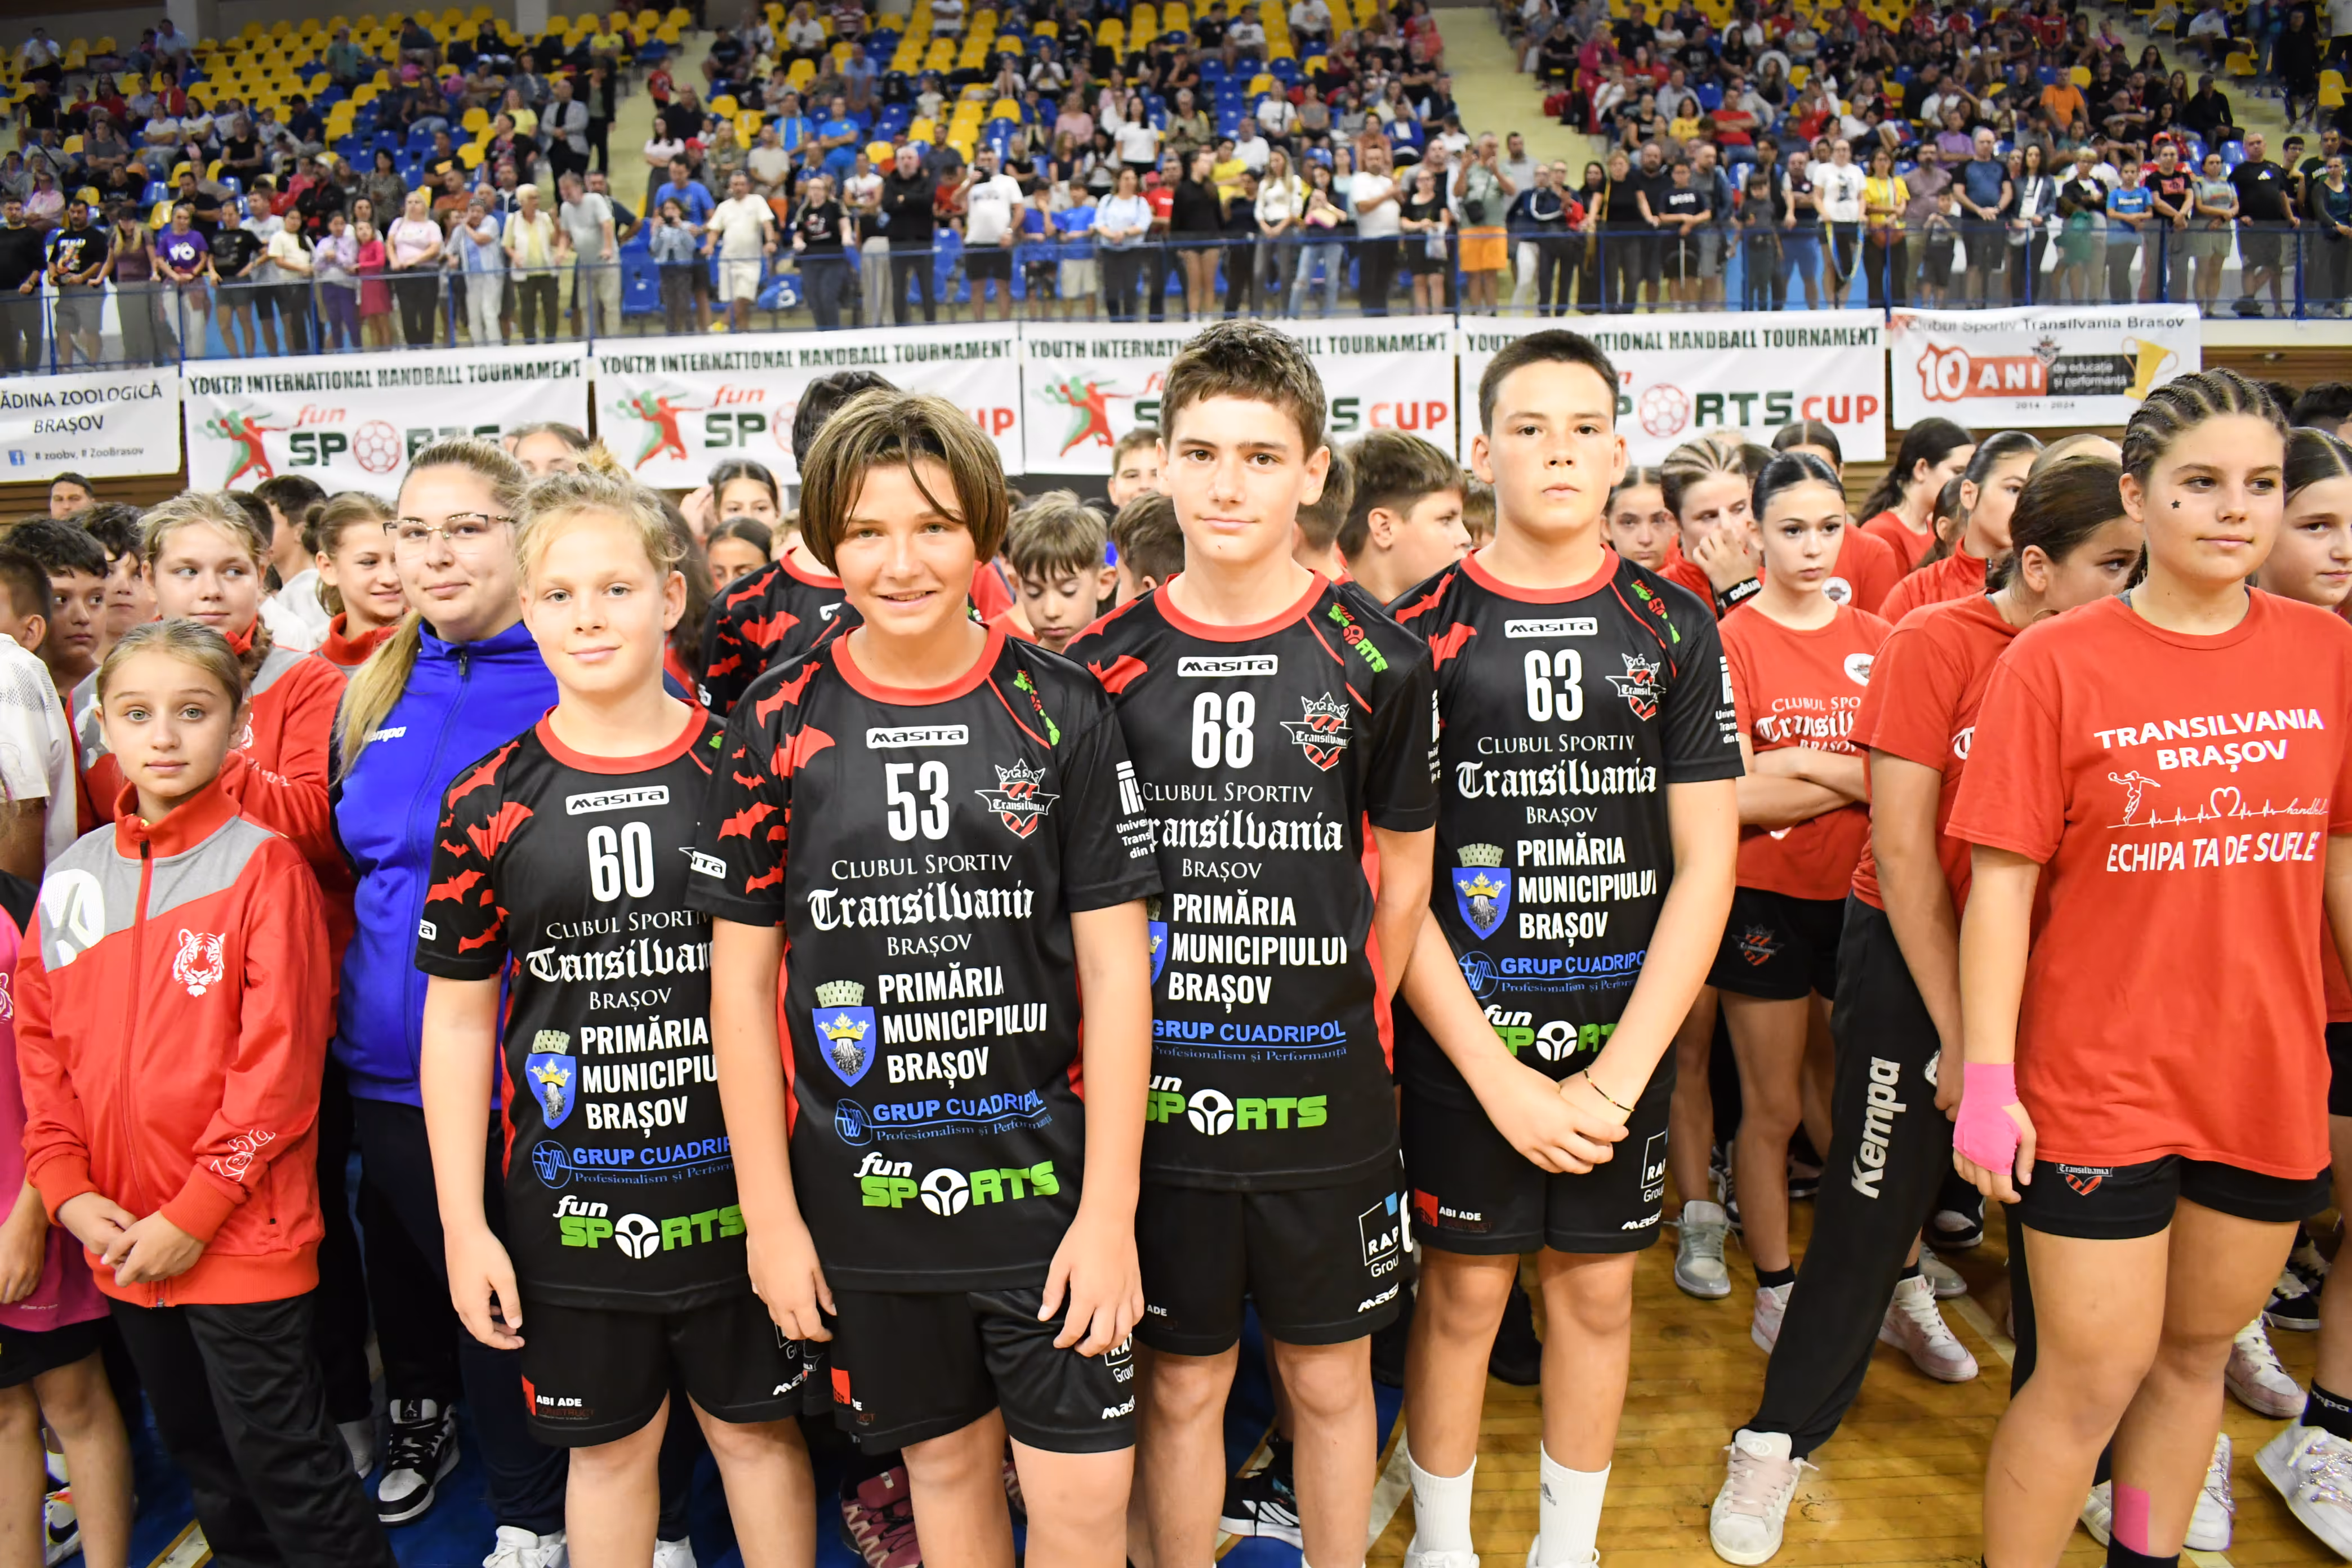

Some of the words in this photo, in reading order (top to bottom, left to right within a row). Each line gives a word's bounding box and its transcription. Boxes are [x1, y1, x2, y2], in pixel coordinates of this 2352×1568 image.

[2024, 318, 2121, 331] Transilvania
[1029, 338, 1088, 358] YOUTH
[1092, 338, 1182, 358] INTERNATI
[1329, 332, 1446, 355] TOURNAMENT
[1467, 333, 1517, 351] YOUT
[1587, 331, 1663, 351] NATIONAL
[1669, 329, 1758, 350] HANDBALL
[1763, 327, 1879, 348] TOURNAMENT
[599, 354, 658, 375] YOUTH
[661, 348, 794, 372] INTERNATIONAL
[800, 345, 889, 368] HANDBALL
[894, 339, 1012, 363] TOURNAMENT
[188, 376, 242, 396] YOUTH
[247, 369, 373, 393] INTERNATIONAL
[377, 365, 464, 389] HANDBALL
[467, 358, 581, 385] TOURNAMENT
[1919, 349, 1970, 399] 10
[1977, 363, 2041, 389] ANI
[0, 390, 56, 409] ĂDINA
[711, 383, 765, 407] fun
[1801, 394, 1878, 424] CUP
[296, 403, 346, 429] fun
[1369, 400, 1449, 430] CUP
[1524, 649, 1583, 722] 63
[1771, 697, 1826, 712] CLUBUL
[369, 727, 407, 742] empa
[1191, 691, 1255, 769] 68
[2093, 709, 2324, 749] TRANSILVANIA
[1477, 737, 1553, 754] CLUBUL
[1558, 734, 1634, 752] SPORTIV
[2157, 739, 2288, 773] BRAȘOV
[1143, 782, 1217, 801] CLUBUL
[1224, 782, 1313, 803] SPORTIV
[1456, 758, 1657, 799] Transilvania
[885, 760, 949, 841] 53
[1526, 806, 1598, 826] BRAȘOV
[1149, 810, 1343, 851] ransilvania
[587, 821, 654, 902] 60
[1517, 832, 1626, 867] PRIMĂRIA
[2106, 841, 2185, 872] ECHIPA
[2193, 838, 2219, 867] TA
[2225, 834, 2252, 865] DE
[831, 858, 917, 880] CLUBUL
[925, 854, 1013, 875] SPORTIV
[1182, 858, 1262, 882] BRAȘOV
[1518, 869, 1657, 903] MUNICIPIULUI
[1173, 889, 1297, 926] PRIMĂRIA
[1520, 911, 1609, 947] BRAȘOV
[887, 933, 972, 957] BRAȘOV
[1171, 933, 1347, 965] MUNICIPIULUI
[1500, 957, 1562, 975] GRUP
[1565, 950, 1645, 973] CUADRIPO
[590, 988, 672, 1011] BRAȘOV
[1168, 972, 1272, 1013] BRAȘOV
[1502, 981, 1585, 993] Profesionalism
[581, 1015, 709, 1055] PRIMĂRIA
[1220, 1020, 1346, 1042] CUADRIPOL
[887, 1046, 989, 1089] BRAȘOV
[1267, 1046, 1347, 1062] Performanță
[582, 1054, 718, 1093] MUNICIPIU
[585, 1095, 688, 1138] BRAȘOV
[873, 1099, 941, 1121] GRUP
[946, 1089, 1044, 1117] CUADRIPOL
[876, 1124, 974, 1142] Profesionalism
[1851, 1057, 1907, 1200] Kempa
[573, 1148, 635, 1165] GRUP
[640, 1136, 730, 1165] CUADRIP
[853, 1151, 913, 1178] fun
[574, 1172, 667, 1186] Profesionalism
[553, 1195, 609, 1218] fun
[1439, 1206, 1456, 1218] ABI
[1459, 1211, 1481, 1222] ADE
[1371, 1254, 1398, 1277] Grou
[1147, 1304, 1167, 1317] ADE
[536, 1395, 554, 1406] ABI
[557, 1397, 582, 1407] ADE
